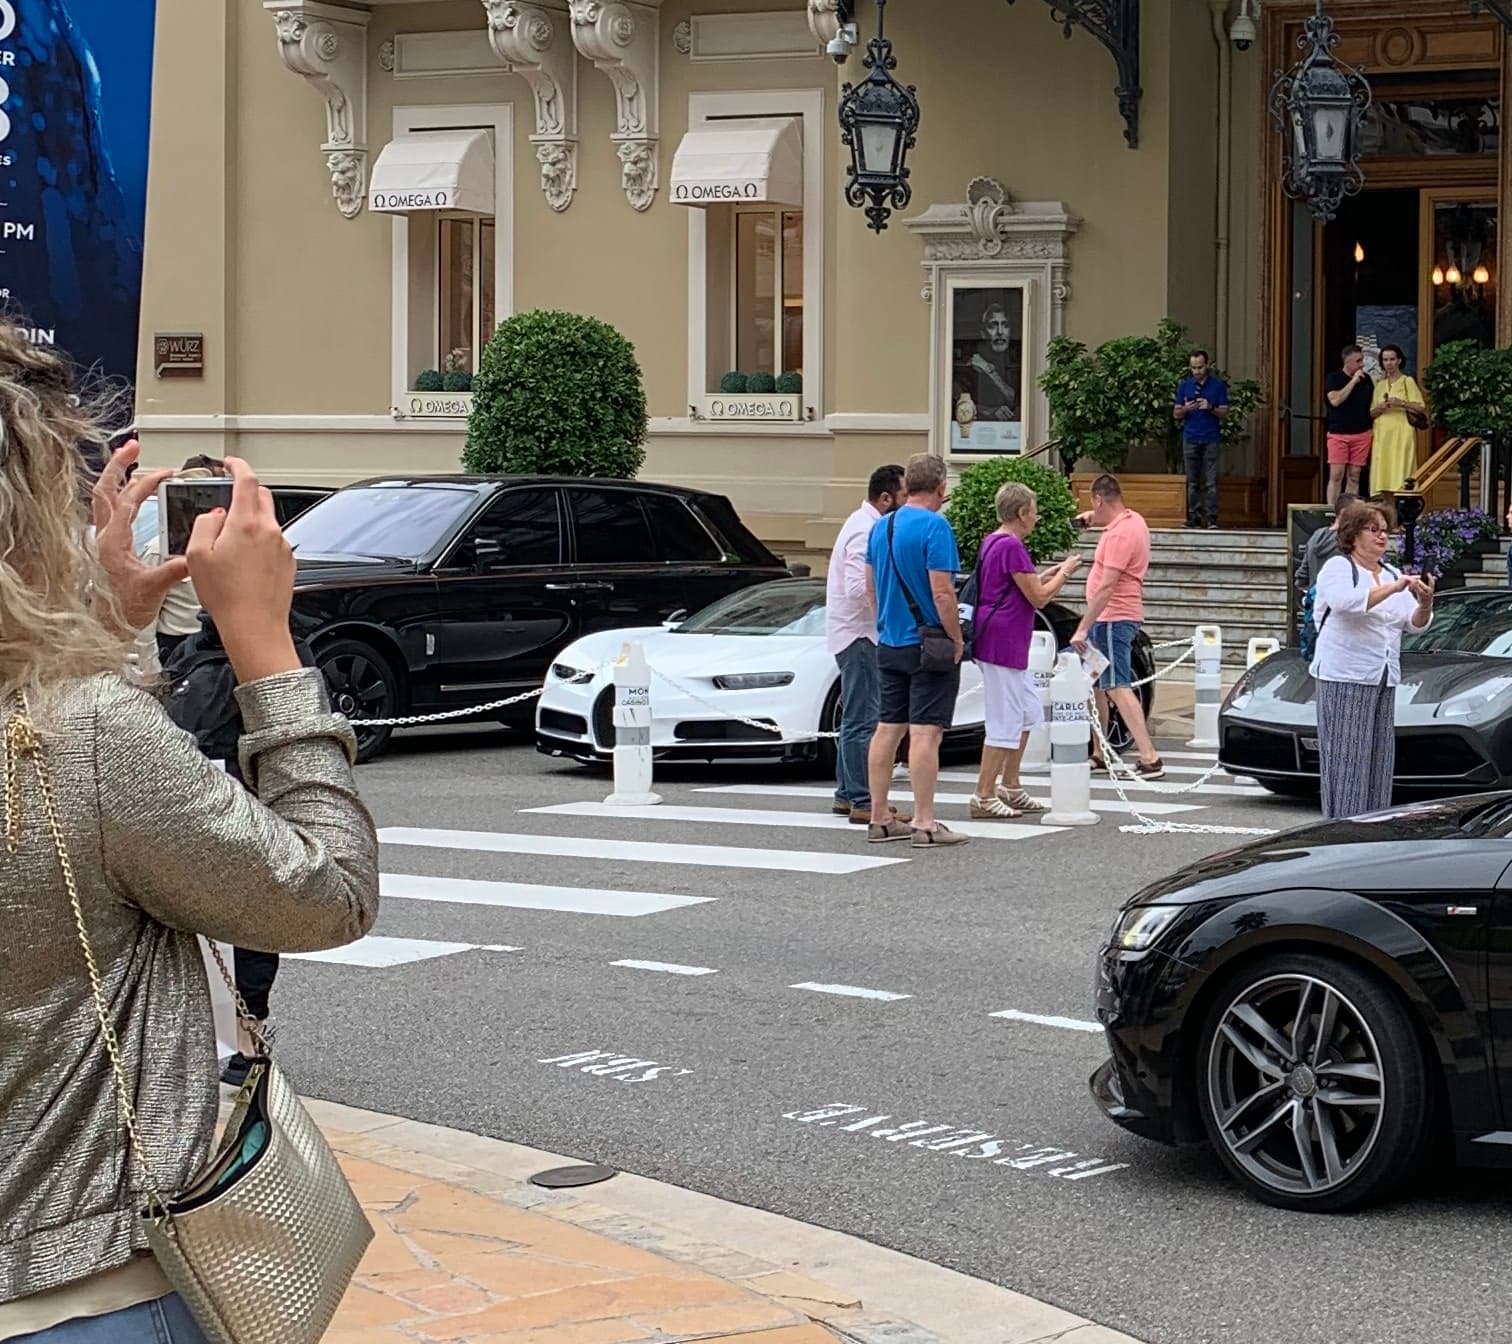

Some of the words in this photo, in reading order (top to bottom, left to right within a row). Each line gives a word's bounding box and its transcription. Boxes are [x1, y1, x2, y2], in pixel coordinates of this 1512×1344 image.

[692, 185, 741, 199] OMEGA
[389, 194, 432, 208] OMEGA
[4, 223, 34, 240] PM
[426, 400, 469, 414] OMEGA
[728, 402, 775, 416] OMEGA
[628, 687, 649, 695] MON
